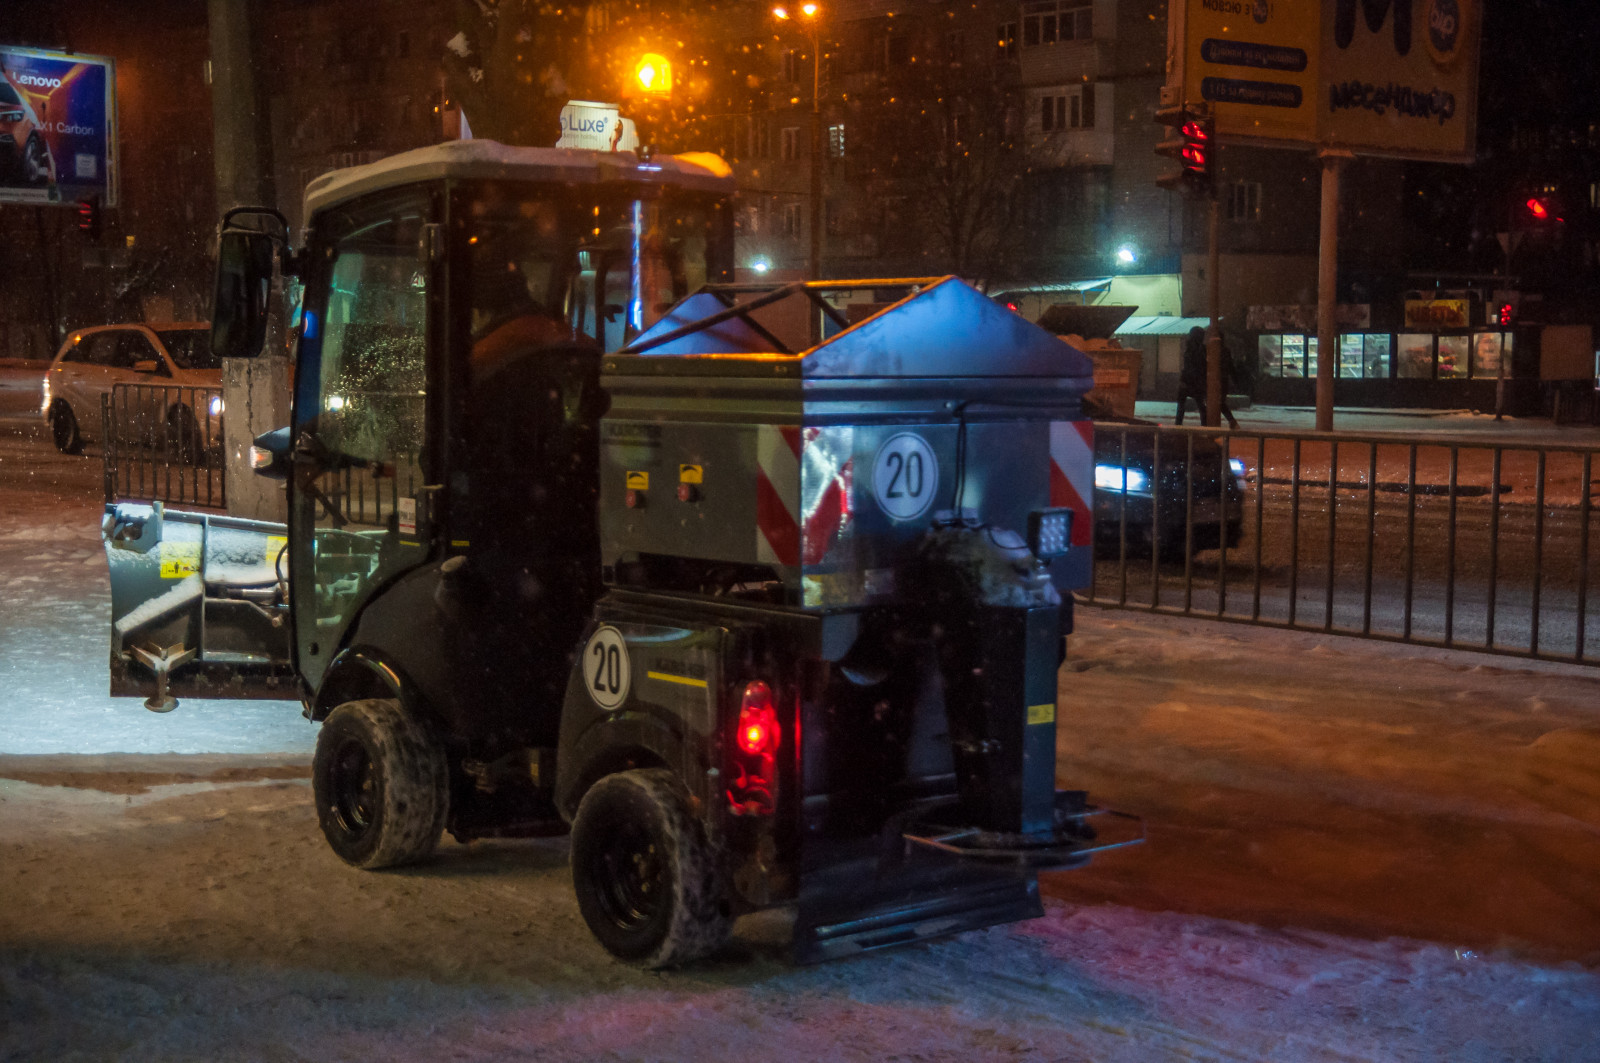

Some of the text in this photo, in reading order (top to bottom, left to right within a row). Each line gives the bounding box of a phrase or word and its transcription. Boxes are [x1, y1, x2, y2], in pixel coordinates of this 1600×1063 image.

[13, 71, 62, 88] Lenovo
[56, 121, 95, 136] Carbon
[886, 450, 923, 499] 20
[593, 640, 621, 695] 20
